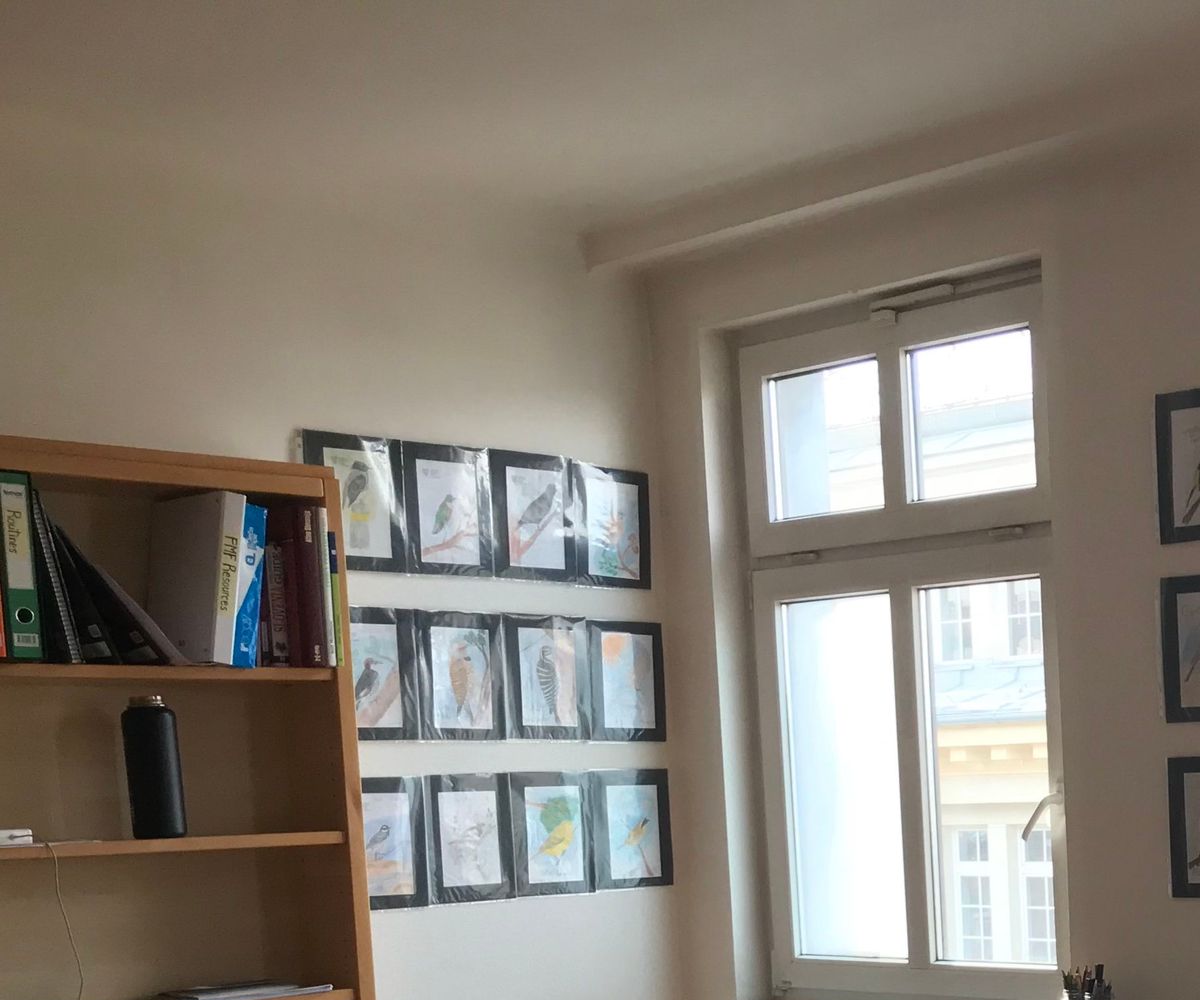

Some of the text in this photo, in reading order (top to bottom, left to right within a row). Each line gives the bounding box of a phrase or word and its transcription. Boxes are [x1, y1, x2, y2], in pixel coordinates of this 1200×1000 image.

[7, 509, 22, 554] Routines
[220, 535, 238, 611] FMF Resources
